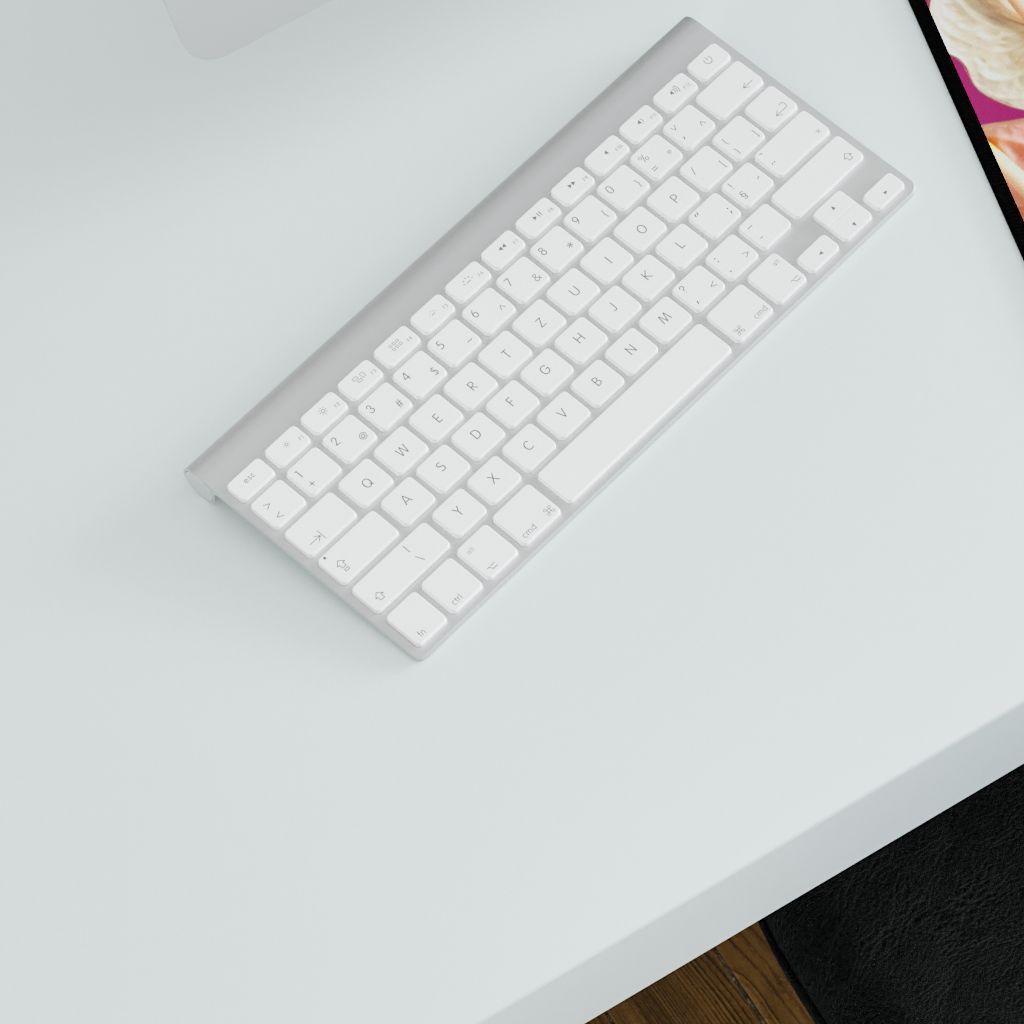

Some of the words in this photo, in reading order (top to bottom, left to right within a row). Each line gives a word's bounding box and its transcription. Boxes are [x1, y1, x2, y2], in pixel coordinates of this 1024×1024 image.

[294, 470, 304, 478] 1
[330, 437, 341, 446] 2
[365, 405, 376, 414] 3
[402, 372, 410, 380] 4
[435, 341, 445, 350] 5
[470, 310, 480, 318] 6
[503, 278, 512, 287] 7
[537, 247, 548, 256] 8
[571, 216, 580, 224] 9
[604, 186, 615, 194] 0
[361, 478, 374, 488] Q
[394, 444, 409, 456] W
[432, 413, 443, 423] E
[466, 381, 477, 391] R
[500, 349, 511, 358] T
[535, 317, 547, 328] Z
[568, 285, 581, 296] U
[636, 224, 648, 234] O
[669, 194, 678, 204] P
[401, 495, 413, 506] A
[435, 462, 447, 472] S
[469, 429, 482, 440] D
[505, 396, 514, 407] F
[539, 364, 551, 375] G
[572, 332, 586, 344] H
[609, 302, 618, 312] J
[640, 271, 652, 280] K
[452, 505, 463, 515] Y
[487, 473, 500, 485] X
[523, 440, 534, 450] C
[556, 408, 567, 417] V
[591, 377, 602, 387] B
[624, 344, 638, 355] N
[658, 312, 672, 324] M
